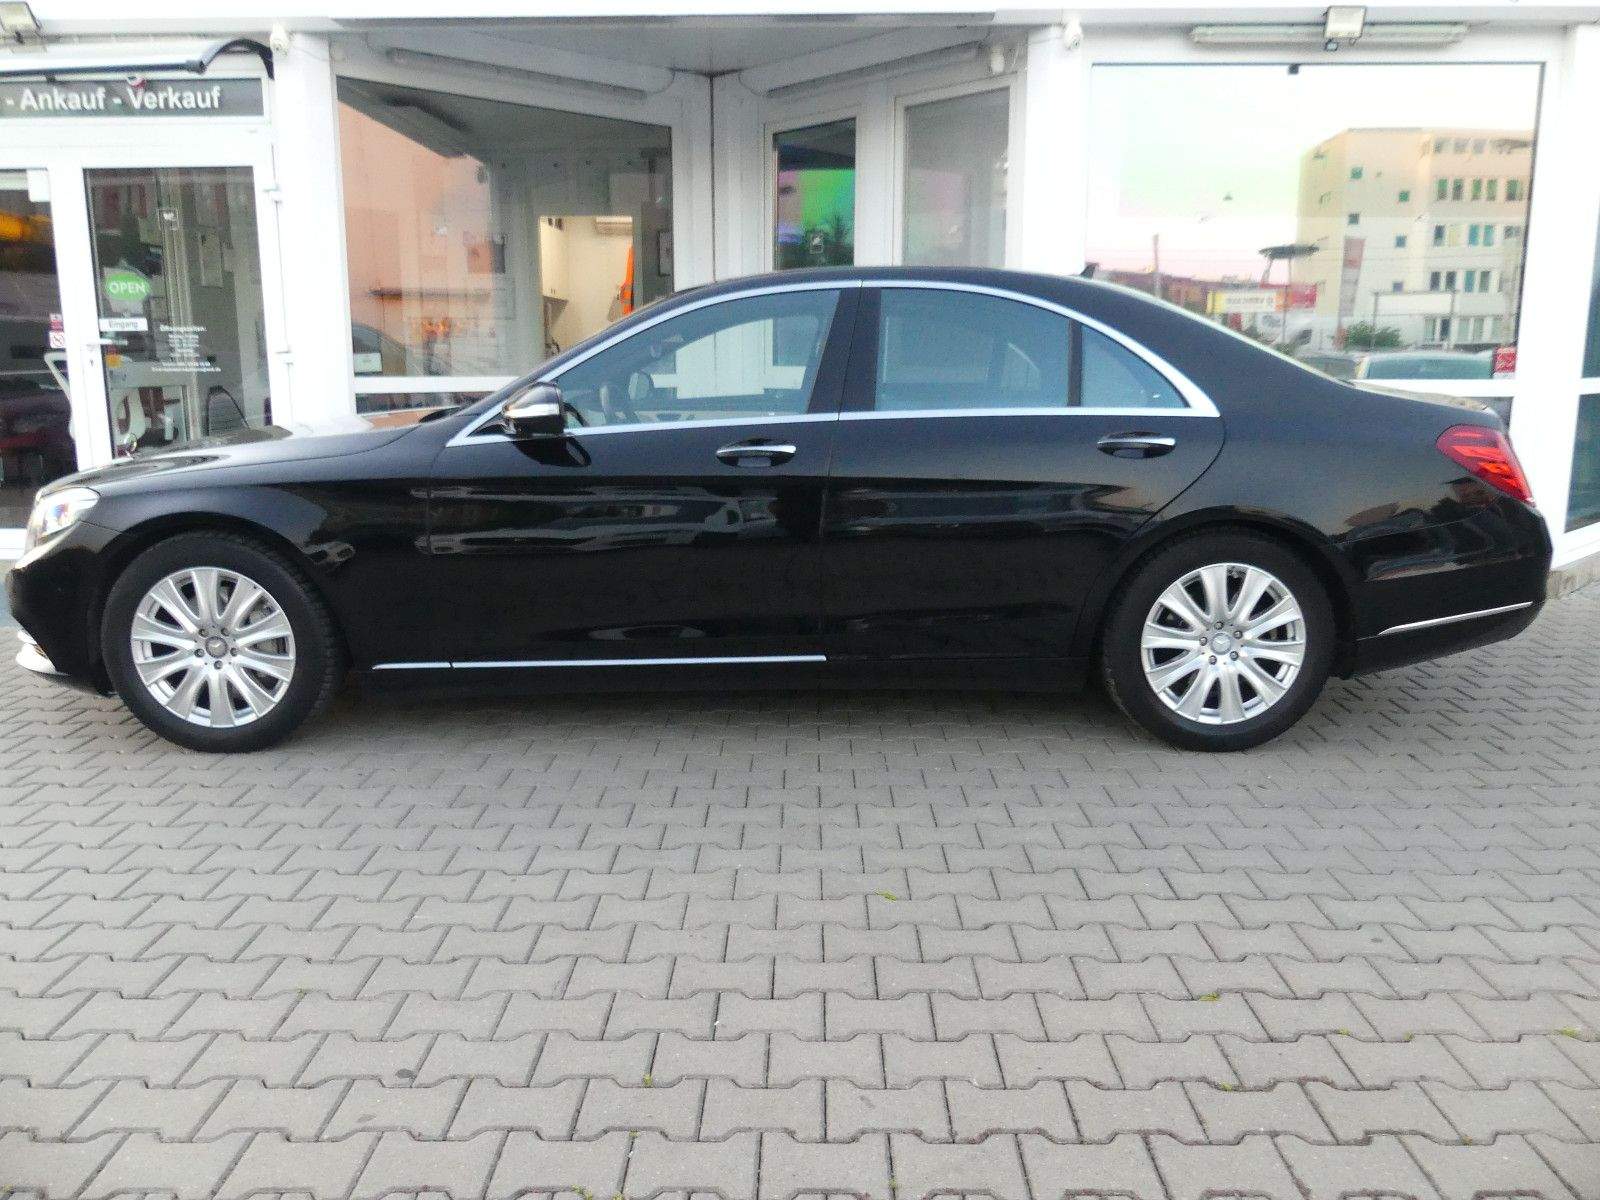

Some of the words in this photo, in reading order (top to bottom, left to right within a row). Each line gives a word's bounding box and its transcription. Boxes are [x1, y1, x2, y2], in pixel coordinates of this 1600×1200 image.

[20, 87, 106, 111] Ankauf
[127, 86, 221, 109] Verkauf
[109, 281, 146, 294] OPEN
